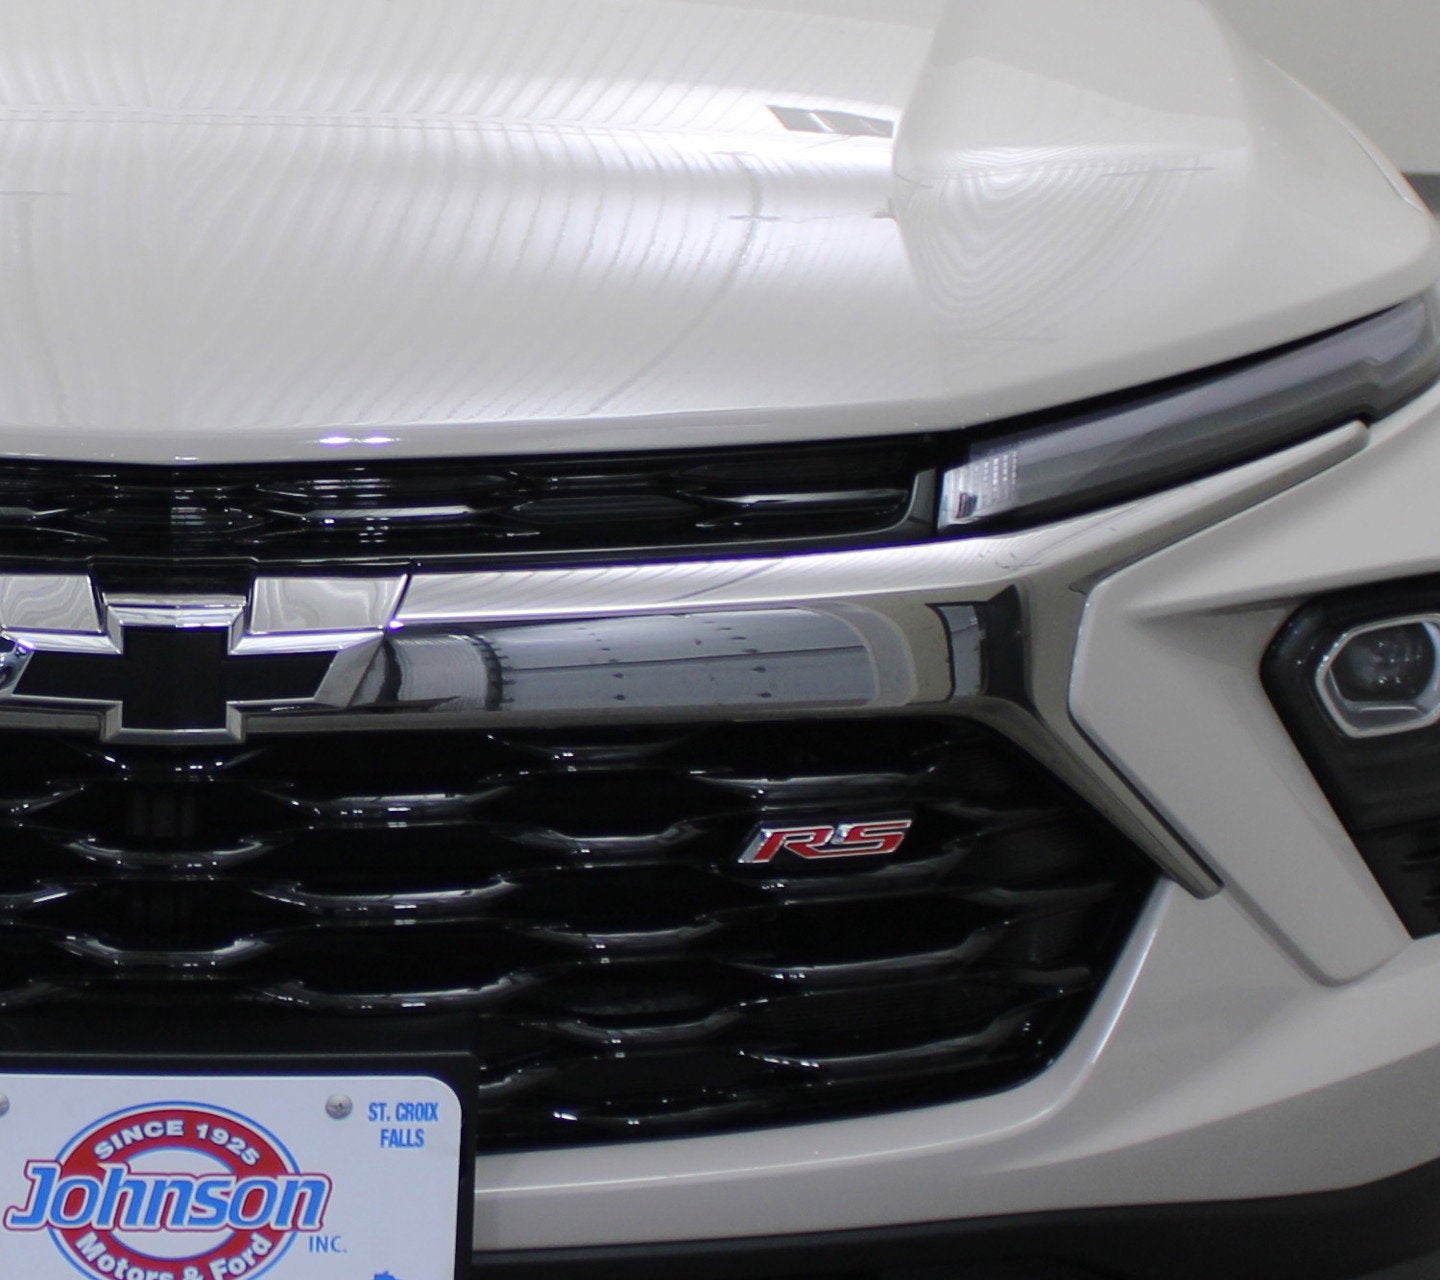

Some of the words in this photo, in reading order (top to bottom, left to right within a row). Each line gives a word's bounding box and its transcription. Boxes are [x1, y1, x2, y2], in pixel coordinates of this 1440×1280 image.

[737, 819, 912, 863] RS
[367, 1102, 391, 1122] ST.
[395, 1102, 439, 1122] CROIX
[93, 1119, 185, 1162] SINCE
[195, 1122, 262, 1167] 1925
[380, 1128, 425, 1148] FALLS
[6, 1160, 330, 1229] Johnson
[308, 1235, 348, 1254] INC.
